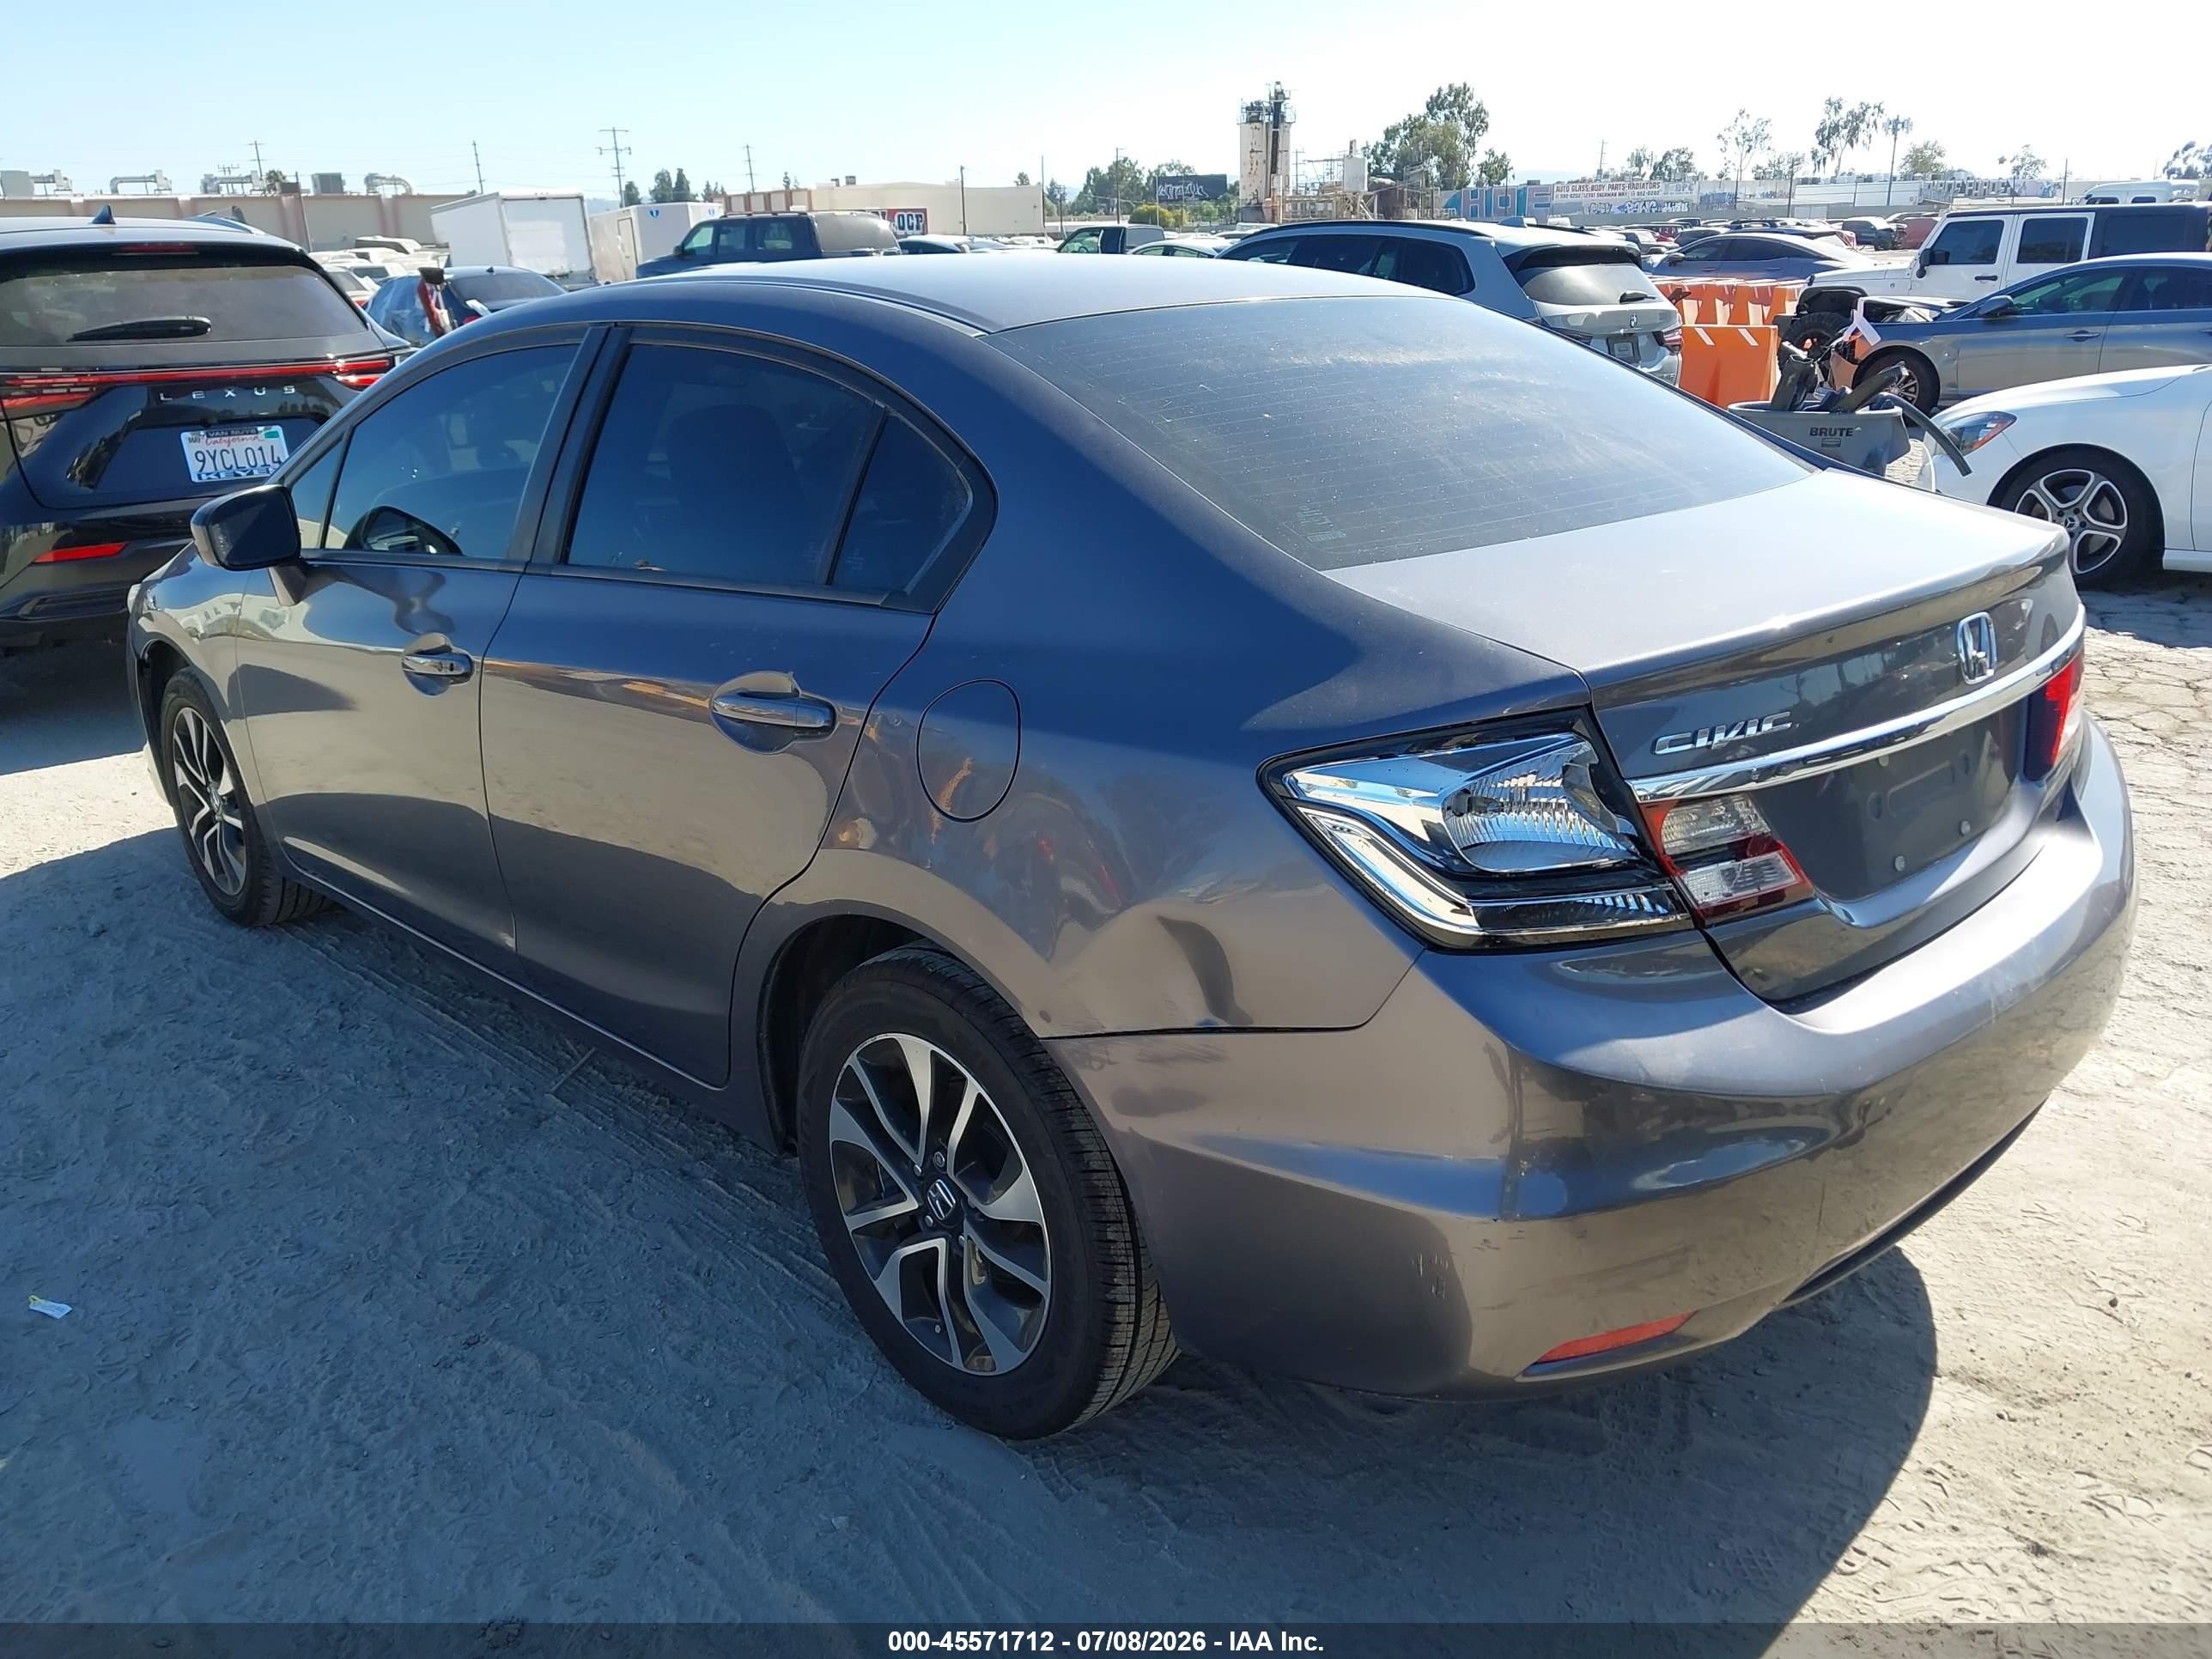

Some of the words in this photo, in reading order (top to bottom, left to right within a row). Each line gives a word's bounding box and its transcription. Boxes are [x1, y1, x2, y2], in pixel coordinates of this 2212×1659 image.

[160, 386, 296, 401] LEXUS
[1809, 427, 1854, 437] BRUTE
[195, 445, 283, 472] 9YCL014
[1654, 711, 1793, 755] CIVIC
